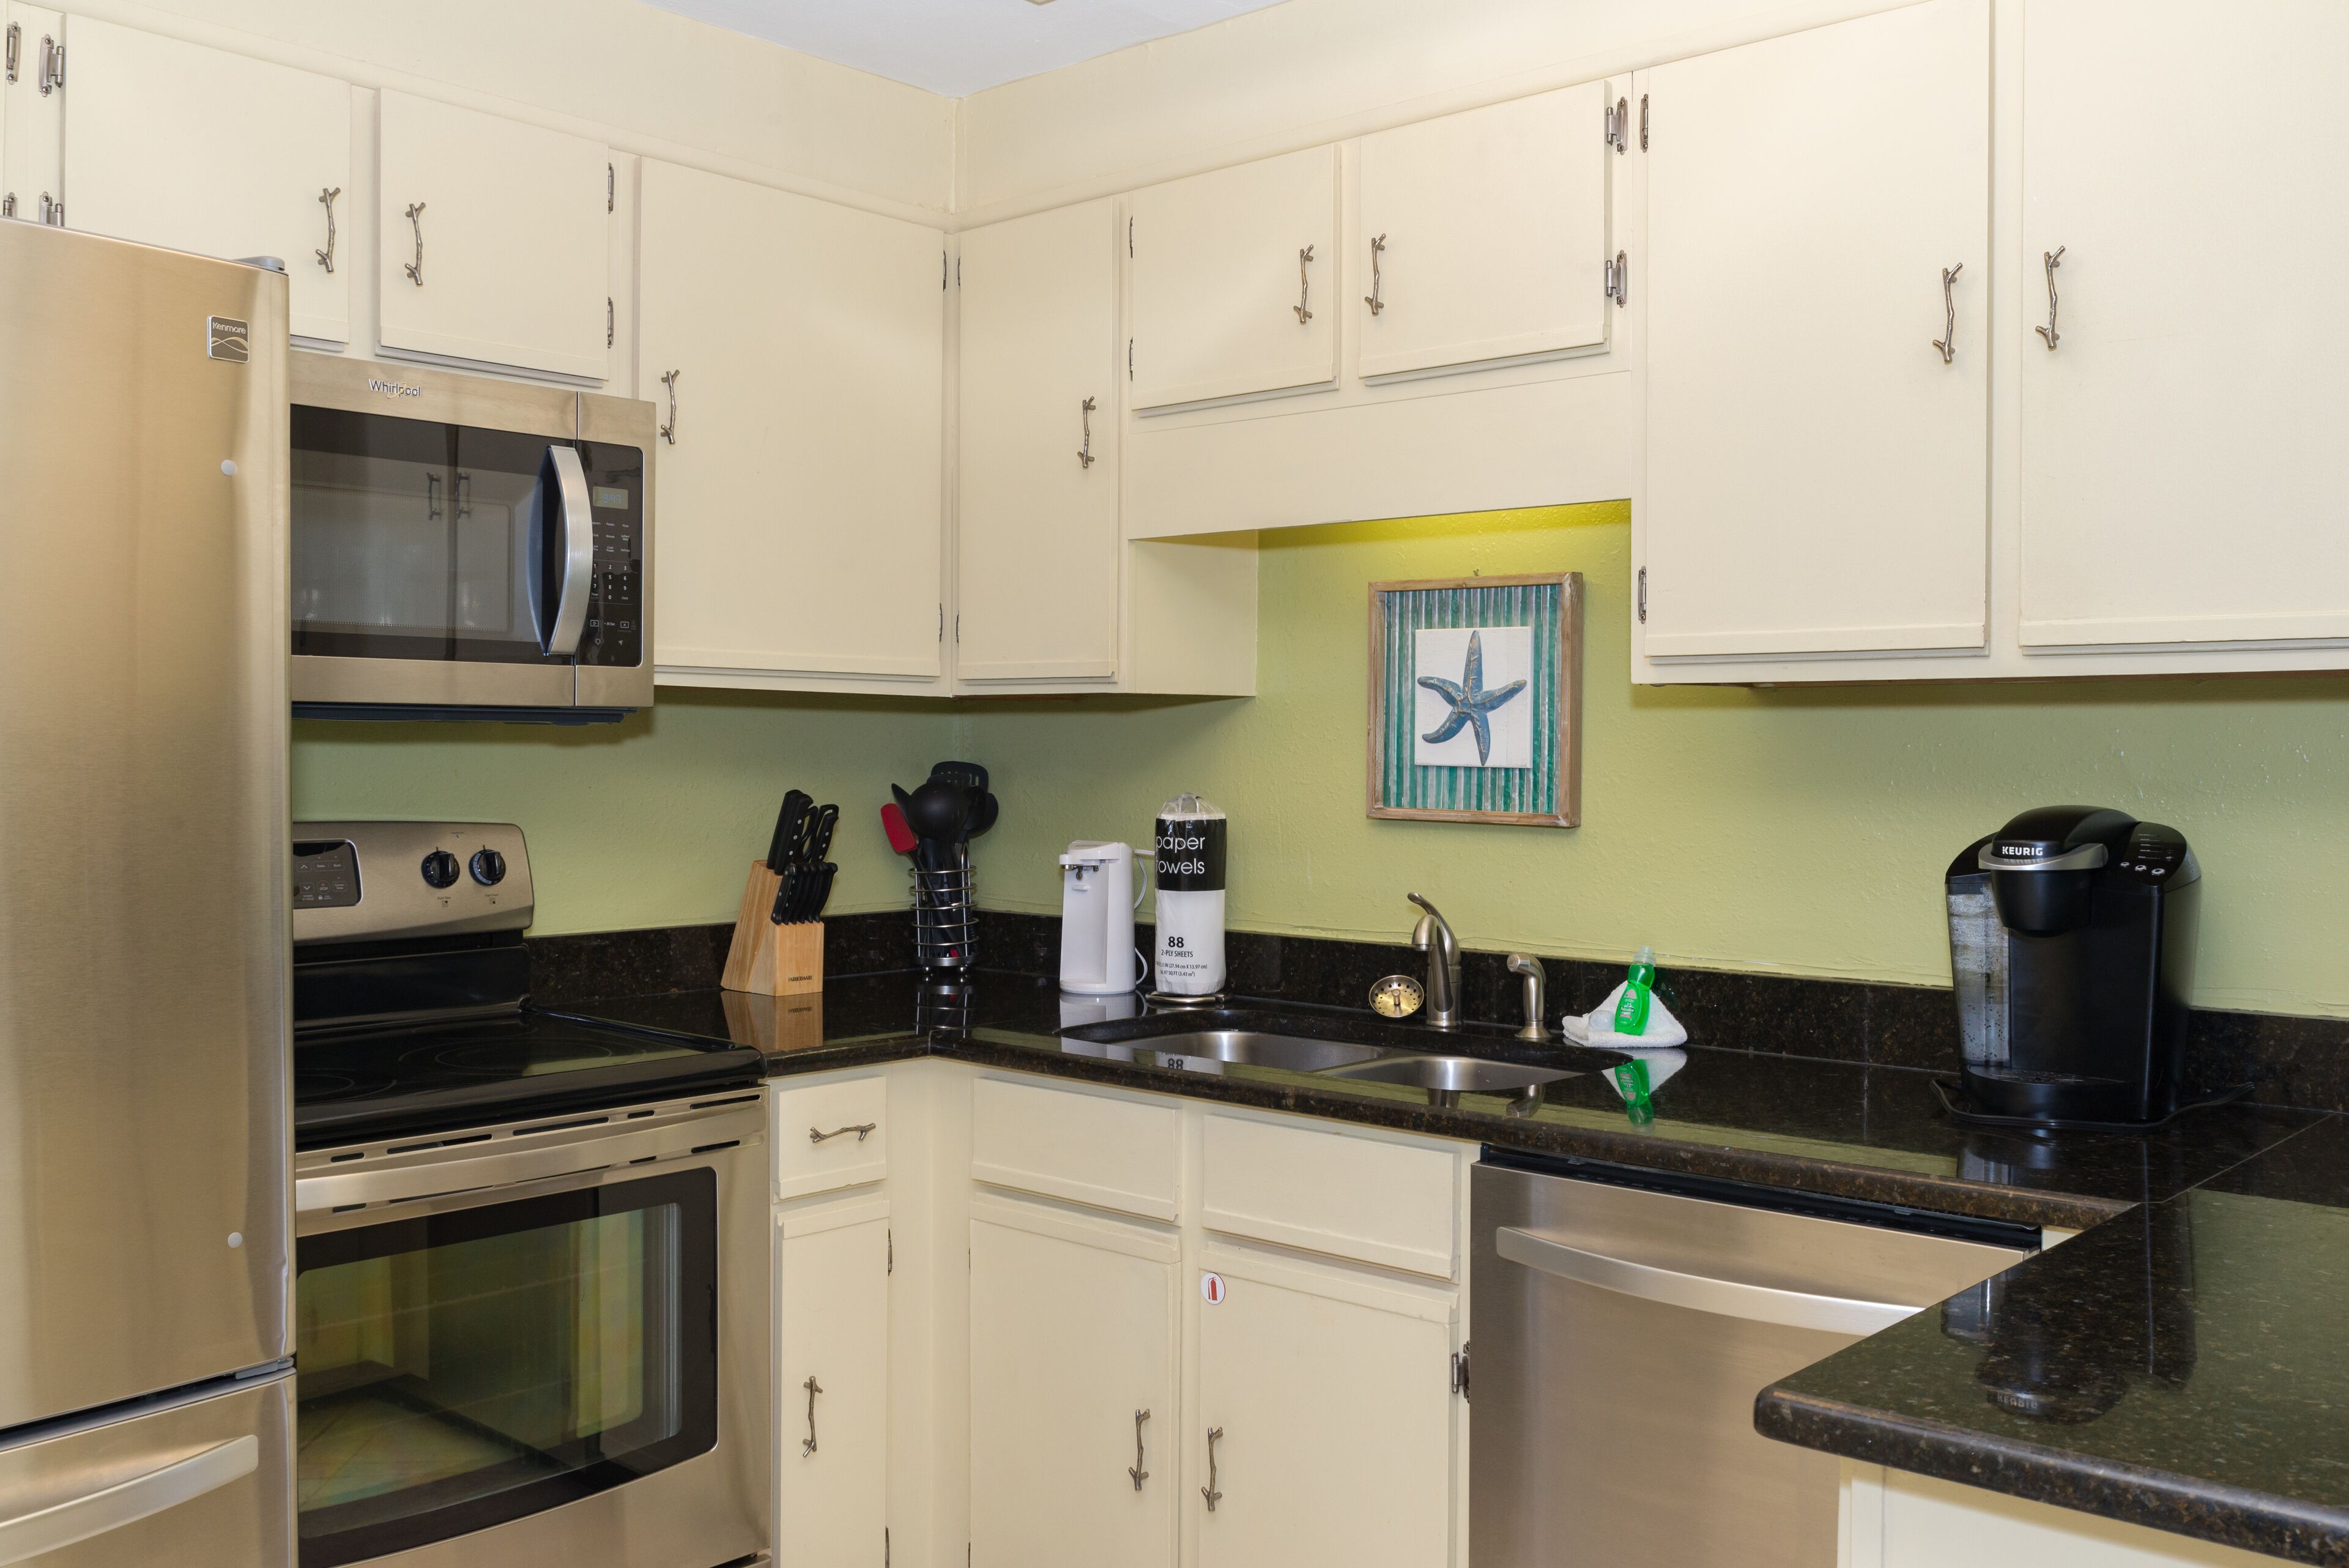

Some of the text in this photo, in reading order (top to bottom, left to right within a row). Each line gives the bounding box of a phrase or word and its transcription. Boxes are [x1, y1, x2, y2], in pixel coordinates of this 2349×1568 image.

[212, 322, 247, 334] Kenmore
[369, 379, 421, 398] Whirlpool
[1156, 836, 1206, 853] paper
[2002, 846, 2043, 856] KEURIG
[1168, 936, 1184, 948] 88
